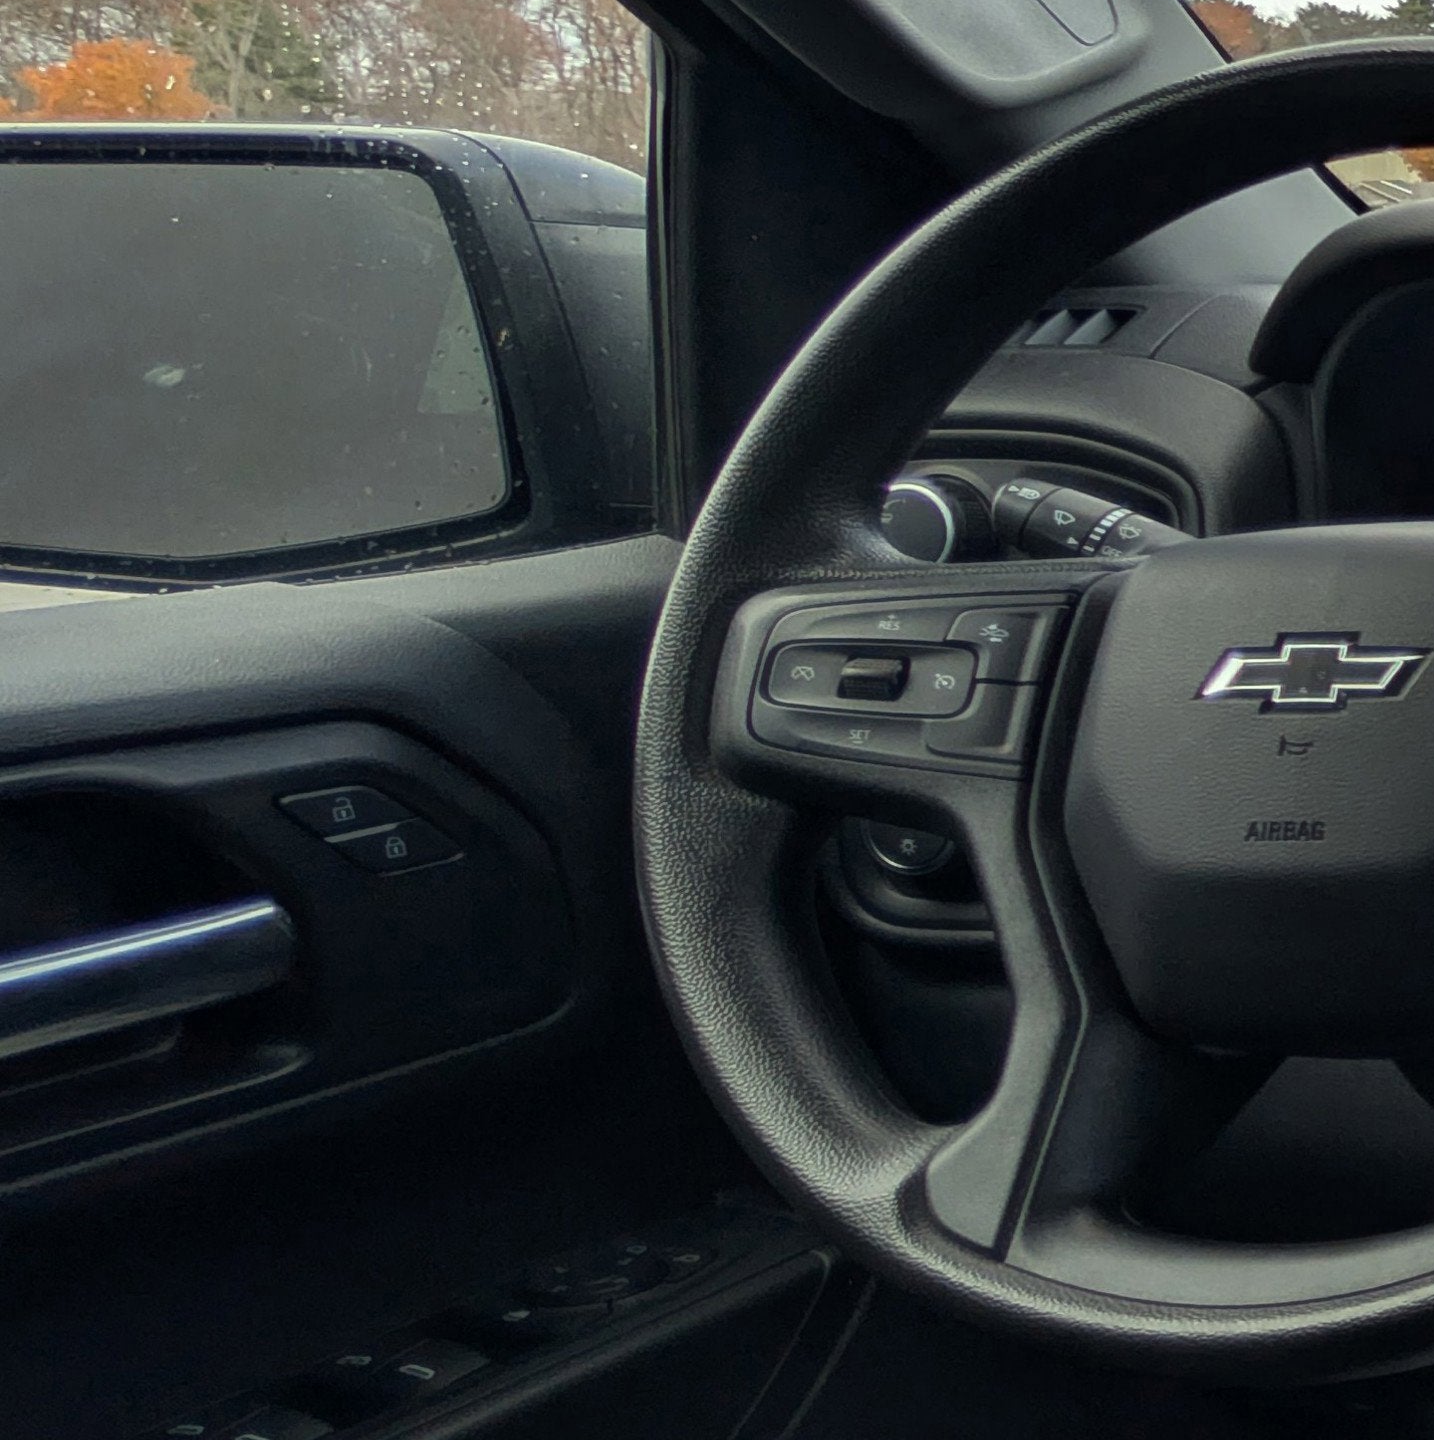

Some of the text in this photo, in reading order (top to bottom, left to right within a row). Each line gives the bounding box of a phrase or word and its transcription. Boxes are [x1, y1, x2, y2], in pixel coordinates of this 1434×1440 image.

[879, 618, 900, 631] RES
[849, 729, 871, 741] SET
[1244, 820, 1325, 842] AIRBAG
